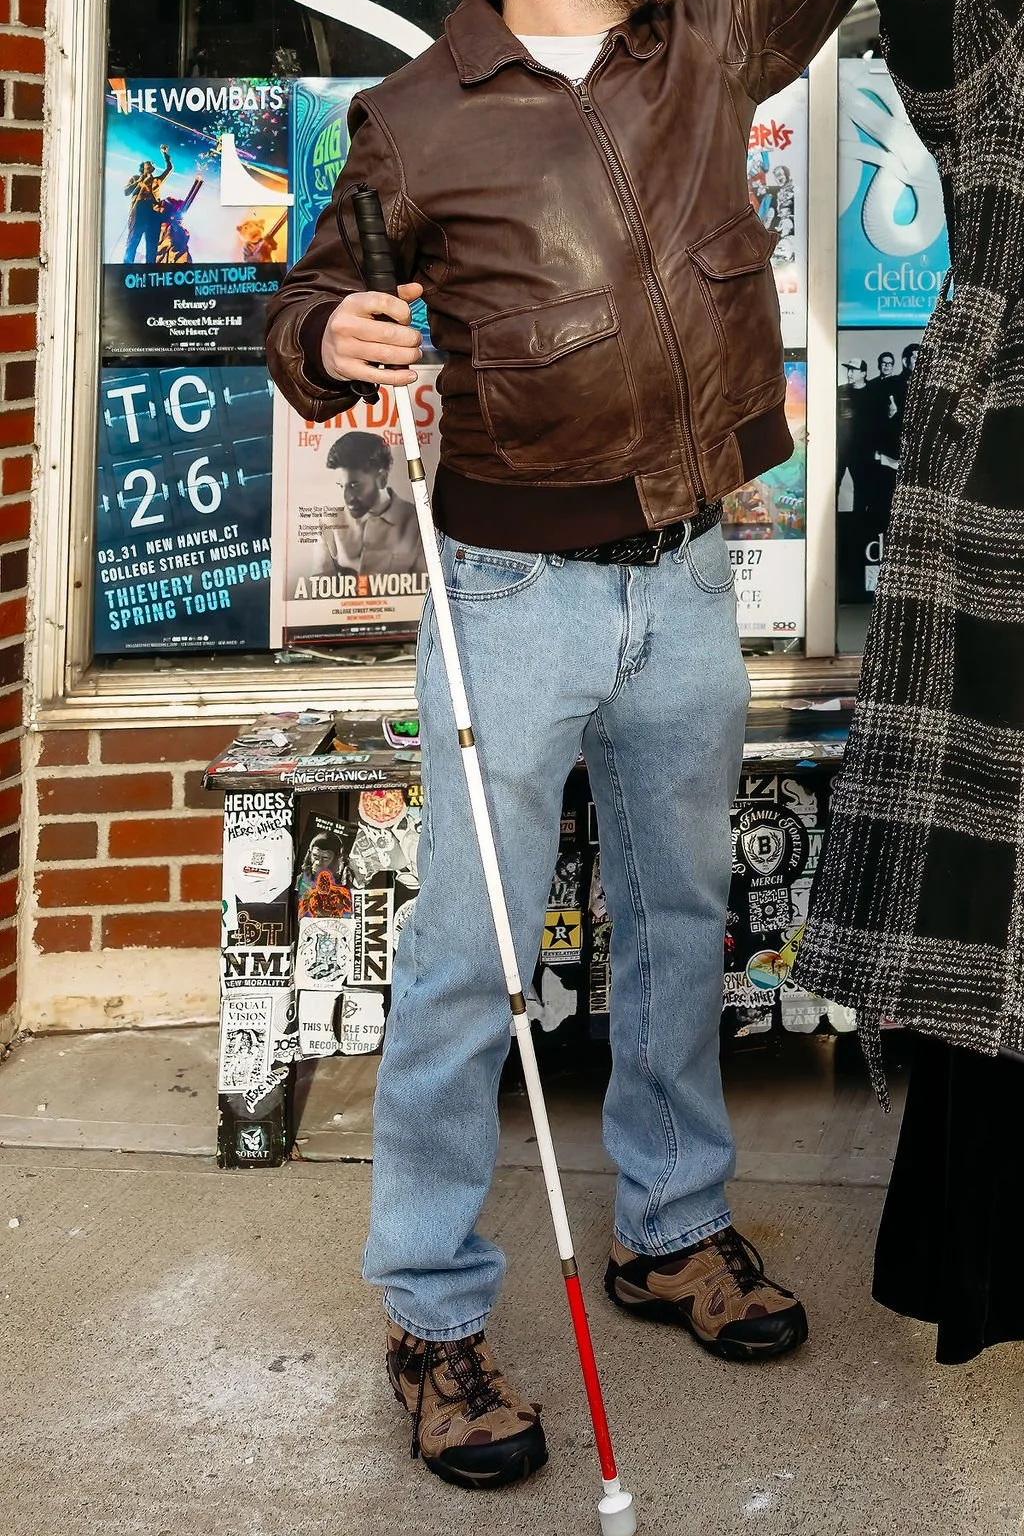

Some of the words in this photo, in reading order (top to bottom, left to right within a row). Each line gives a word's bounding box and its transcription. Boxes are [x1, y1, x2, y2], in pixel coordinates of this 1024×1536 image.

[111, 88, 157, 114] THE
[161, 85, 283, 112] WOMBATS
[313, 118, 341, 167] BIG
[148, 271, 173, 288] THE
[174, 268, 218, 285] OCEAN
[221, 266, 257, 282] TOUR
[209, 300, 216, 310] 9
[146, 316, 177, 328] College
[178, 317, 201, 326] Street
[202, 316, 225, 326] Music
[298, 431, 322, 451] Hey
[123, 455, 223, 528] 26
[98, 544, 138, 564] 03_31
[146, 537, 173, 555] NEW
[176, 524, 239, 549] HAVEN_CT
[101, 560, 156, 584] COLLEGE
[160, 552, 205, 572] STREET
[210, 543, 250, 562] MUSIC
[253, 537, 272, 554] HA
[748, 550, 762, 564] 27
[742, 568, 752, 580] CT
[104, 574, 194, 609] THIEVERY
[294, 577, 308, 600] A
[308, 574, 357, 599] TOUR
[108, 600, 177, 631] SPRING
[182, 589, 232, 616] TOUR
[772, 622, 797, 630] SOHO
[224, 792, 284, 812] HEROES
[740, 808, 780, 831] FAMILY
[757, 835, 772, 855] B
[750, 874, 783, 888] MERCH
[354, 894, 362, 916] NEW
[354, 916, 362, 959] MORALITY
[364, 892, 388, 981] NMZ
[555, 926, 568, 940] R
[354, 960, 362, 980] ZINE
[244, 979, 286, 987] MORALITY
[229, 1000, 267, 1010] EQUAL
[228, 1012, 266, 1020] VISION
[302, 1022, 322, 1032] THIS
[309, 1040, 343, 1050] RECORD
[343, 1034, 360, 1042] ALL
